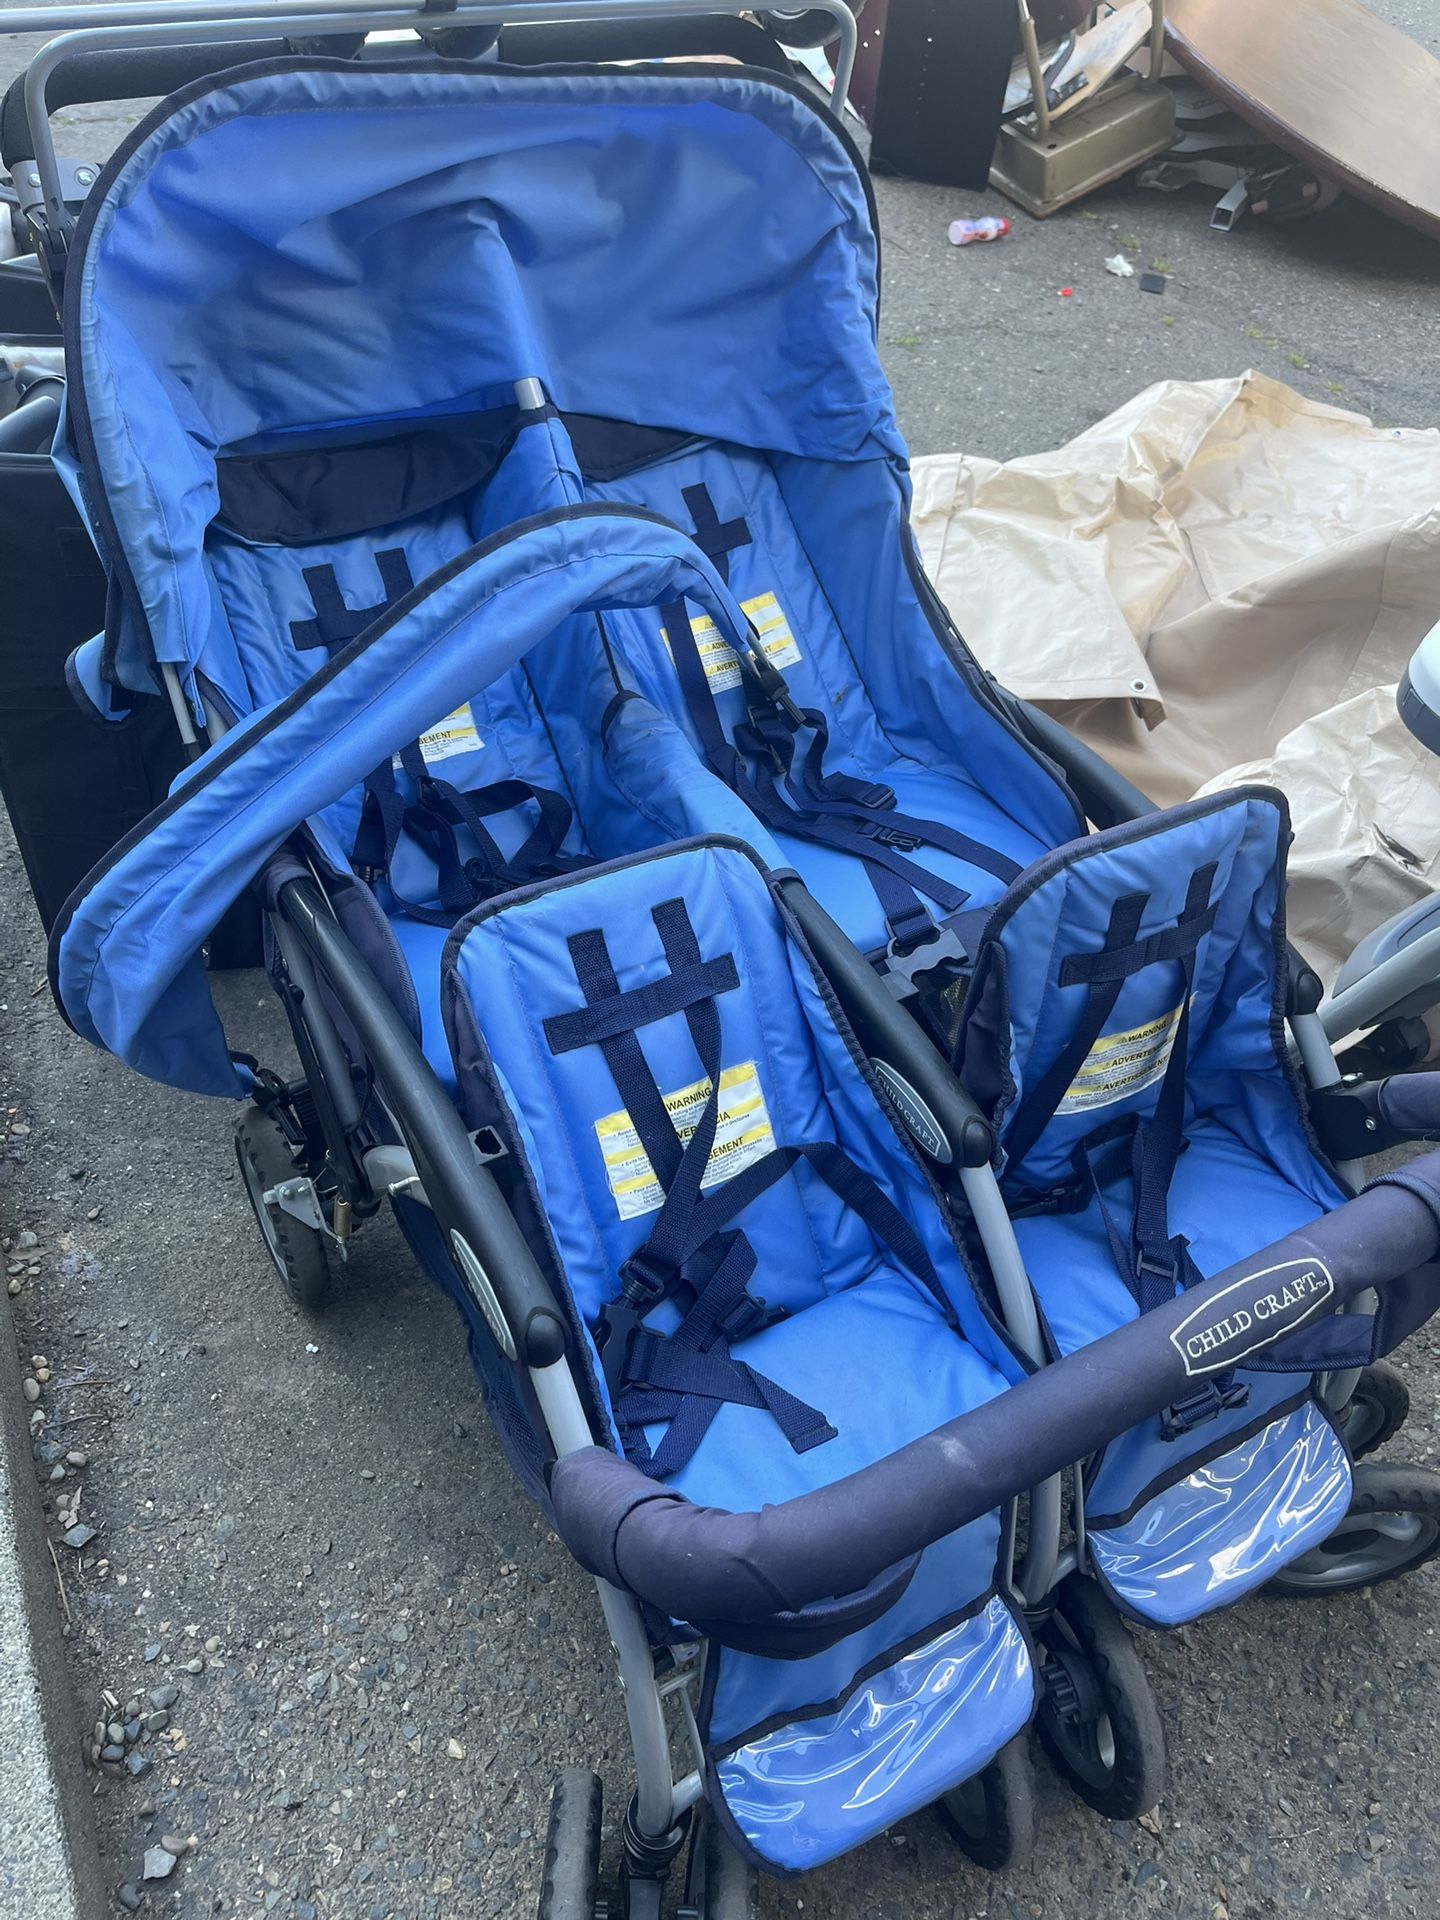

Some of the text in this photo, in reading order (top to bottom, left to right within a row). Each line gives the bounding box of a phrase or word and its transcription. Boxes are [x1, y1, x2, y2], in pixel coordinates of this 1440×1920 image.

[1128, 1021, 1168, 1042] WARNING
[666, 1087, 712, 1111] WARNING
[904, 1110, 935, 1147] CRAFT
[1186, 1310, 1252, 1358] CHILD
[1253, 1271, 1317, 1319] CRAFT
